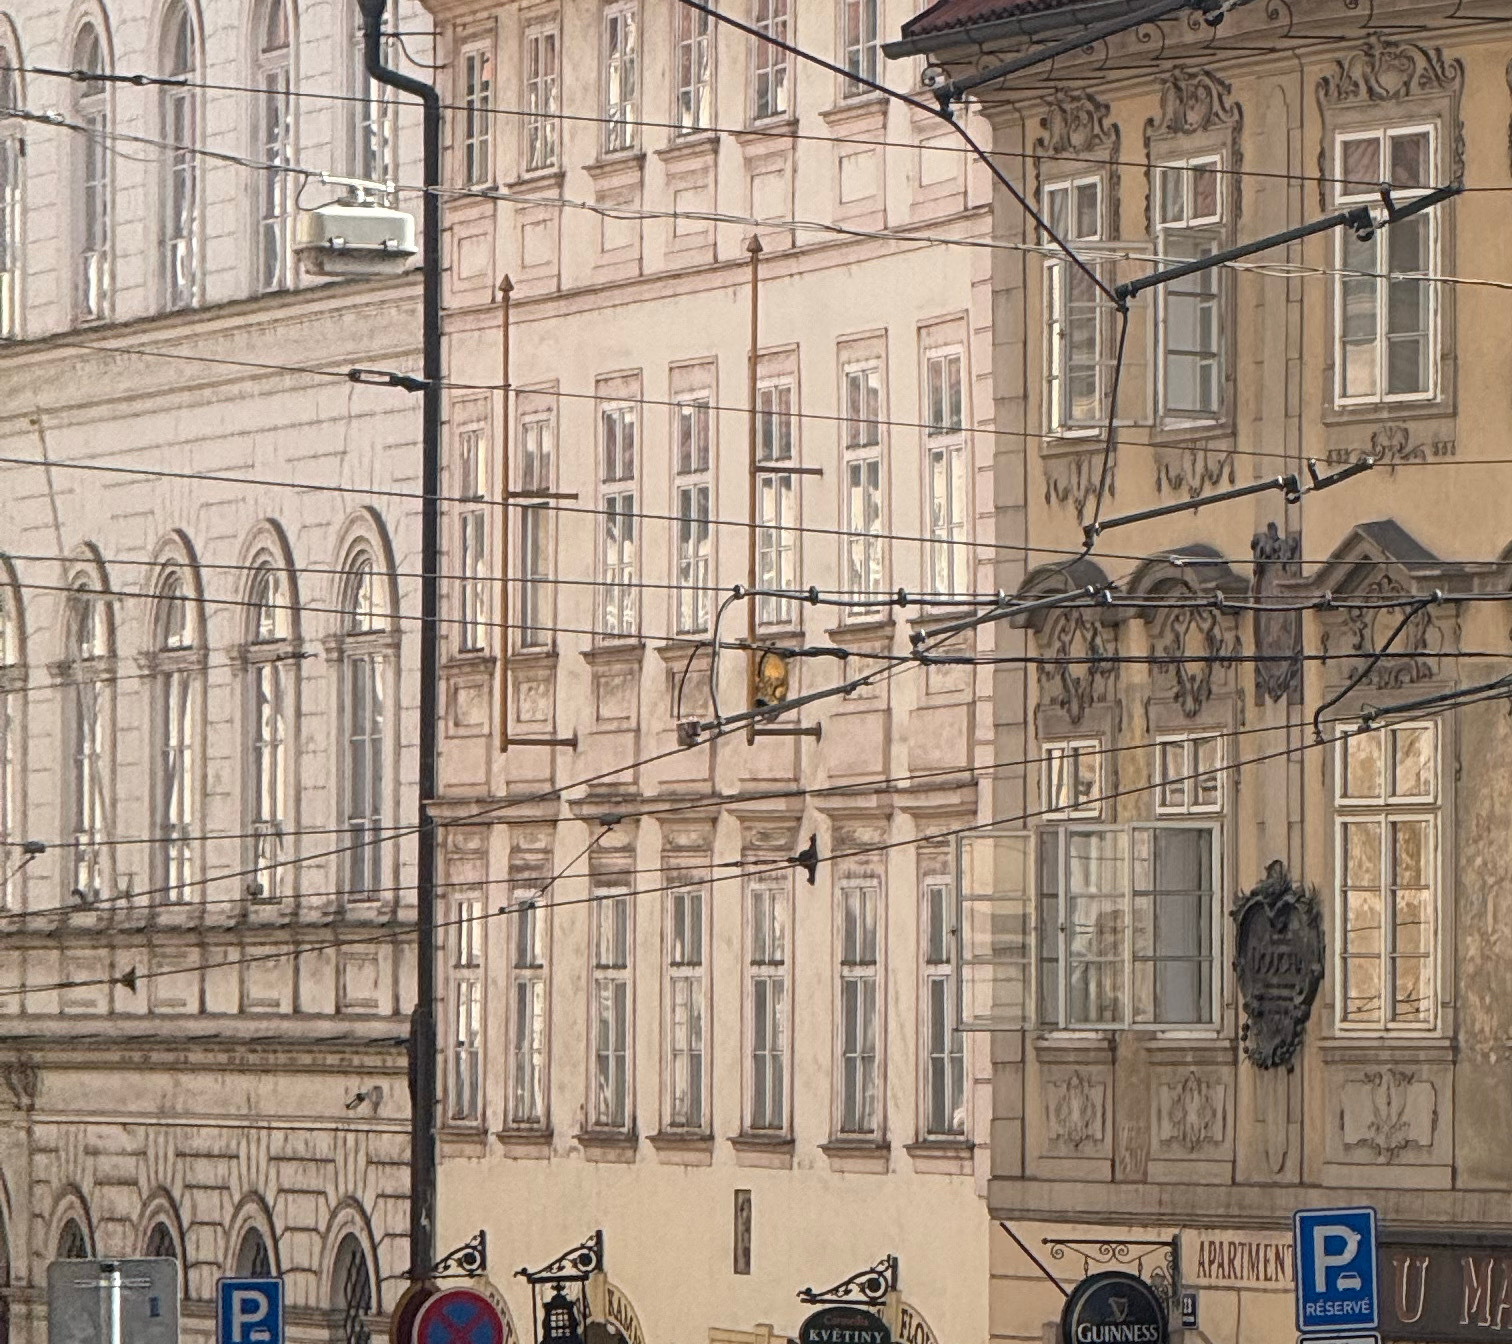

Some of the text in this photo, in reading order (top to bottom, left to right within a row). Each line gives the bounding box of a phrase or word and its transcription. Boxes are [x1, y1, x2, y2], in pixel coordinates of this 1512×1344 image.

[1313, 1225, 1361, 1293] P
[1306, 1297, 1371, 1317] RÉSERVÉ
[1392, 1256, 1429, 1323] U
[232, 1290, 269, 1343] P
[1077, 1323, 1158, 1343] GUINNESS
[809, 1327, 884, 1344] KVĚTINY
